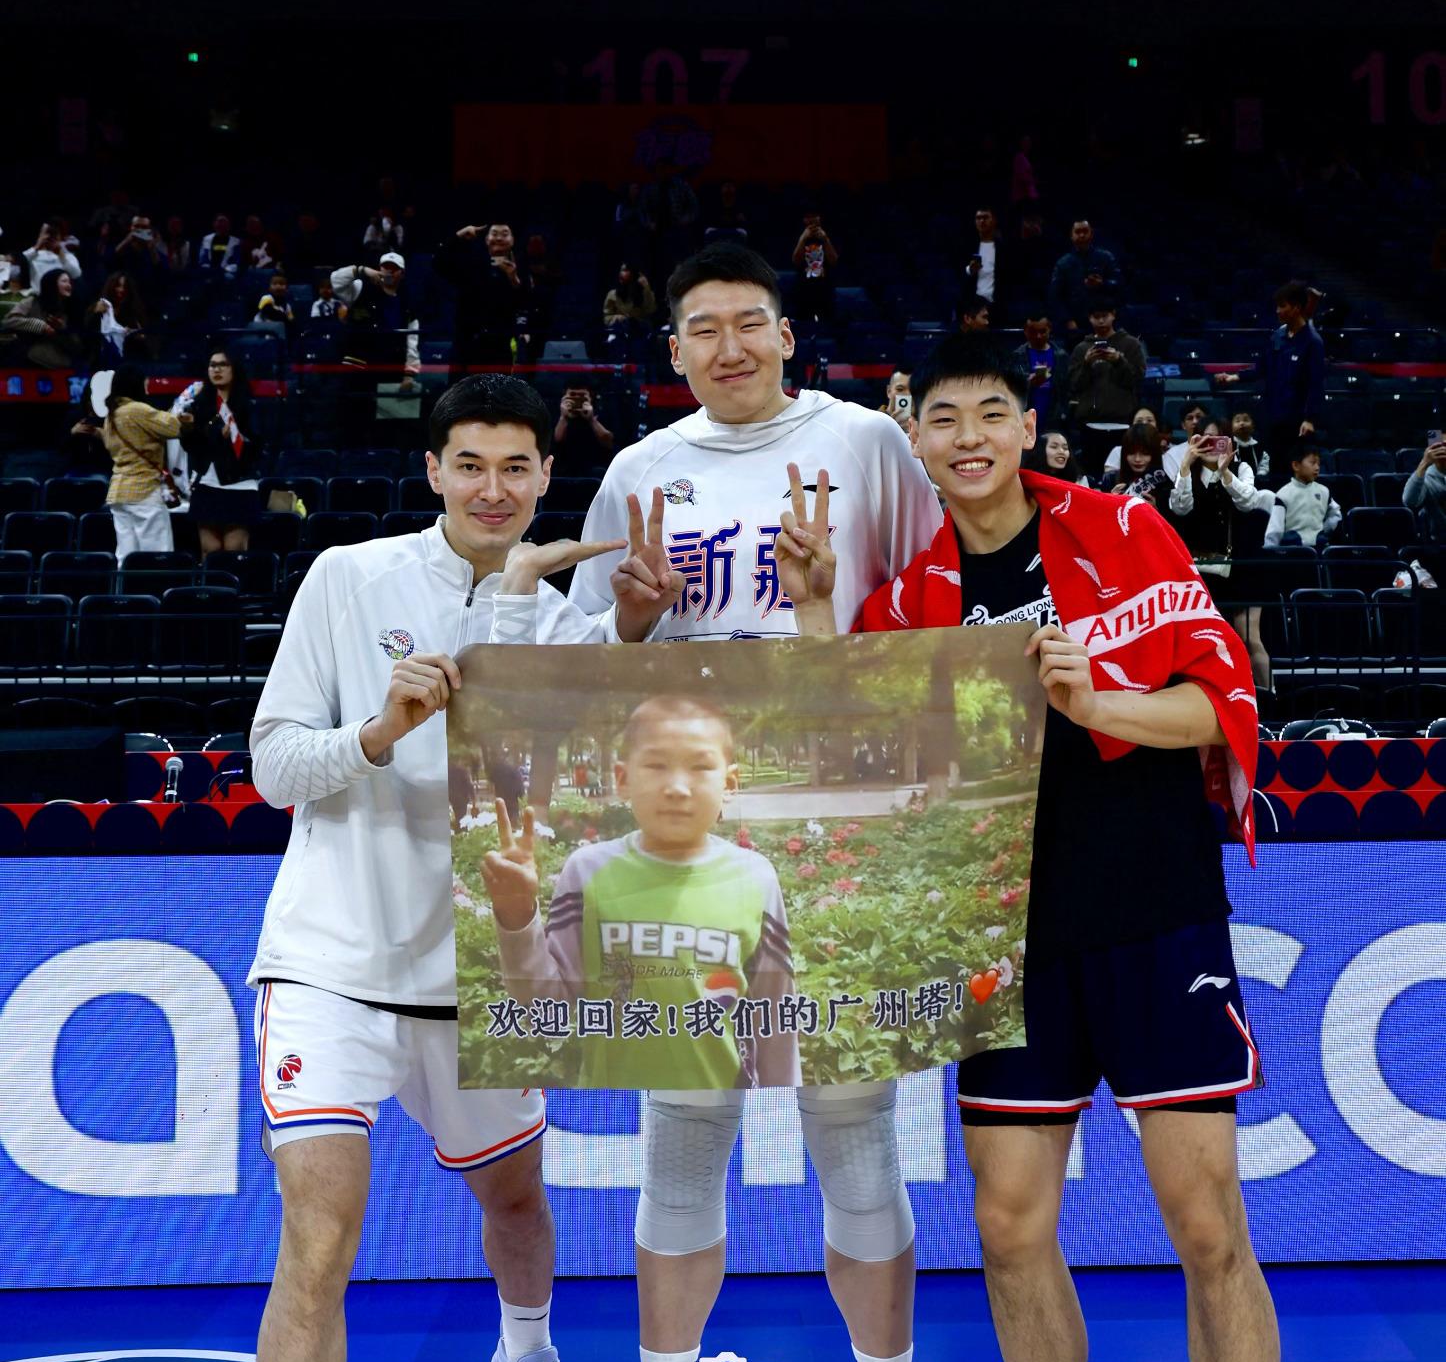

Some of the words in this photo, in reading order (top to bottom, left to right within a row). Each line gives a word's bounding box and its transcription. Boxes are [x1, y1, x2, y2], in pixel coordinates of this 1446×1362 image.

[1083, 582, 1215, 647] Anythin
[600, 920, 742, 968] PEPSI
[660, 966, 704, 980] MORE
